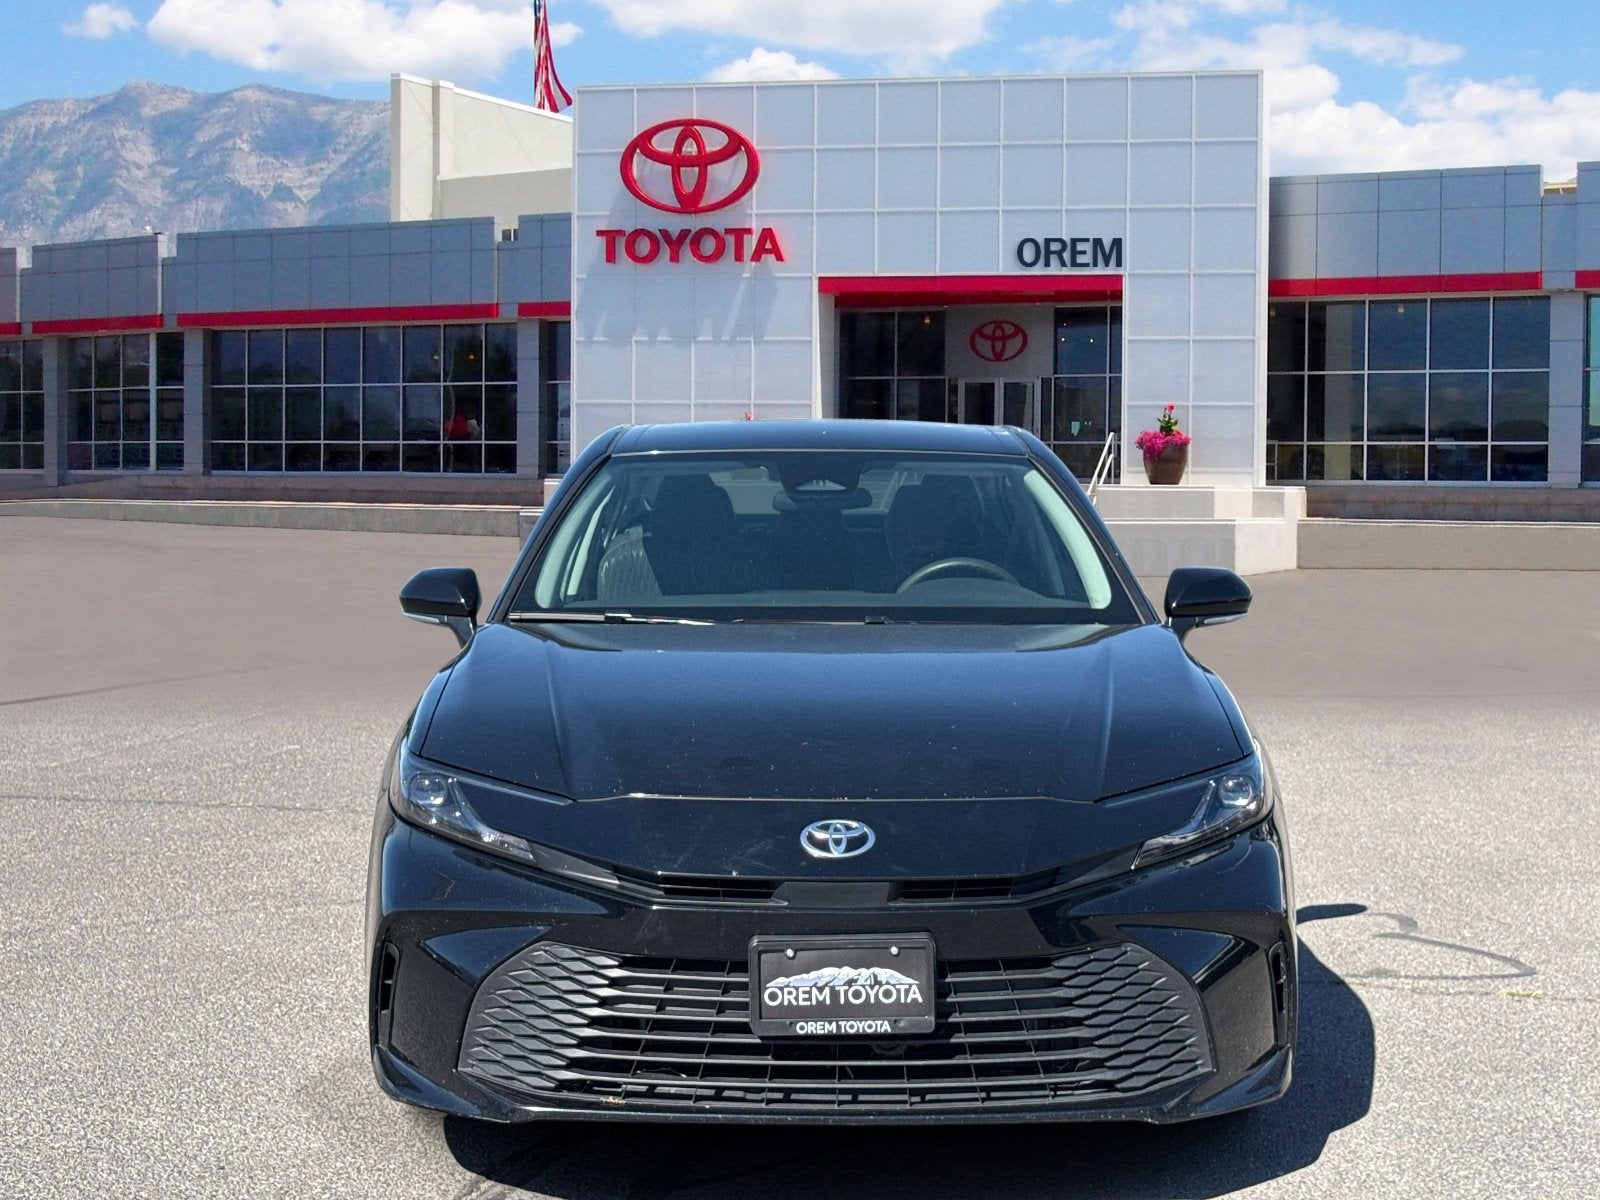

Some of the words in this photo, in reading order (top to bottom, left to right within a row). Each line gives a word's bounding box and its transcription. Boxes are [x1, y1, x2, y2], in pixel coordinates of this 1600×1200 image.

[596, 227, 785, 263] TOYOTA
[1016, 237, 1123, 268] OREM
[764, 986, 831, 1006] OREM
[835, 984, 923, 1005] TOYOTA
[796, 1021, 837, 1034] OREM
[838, 1020, 891, 1034] TOYOTA
